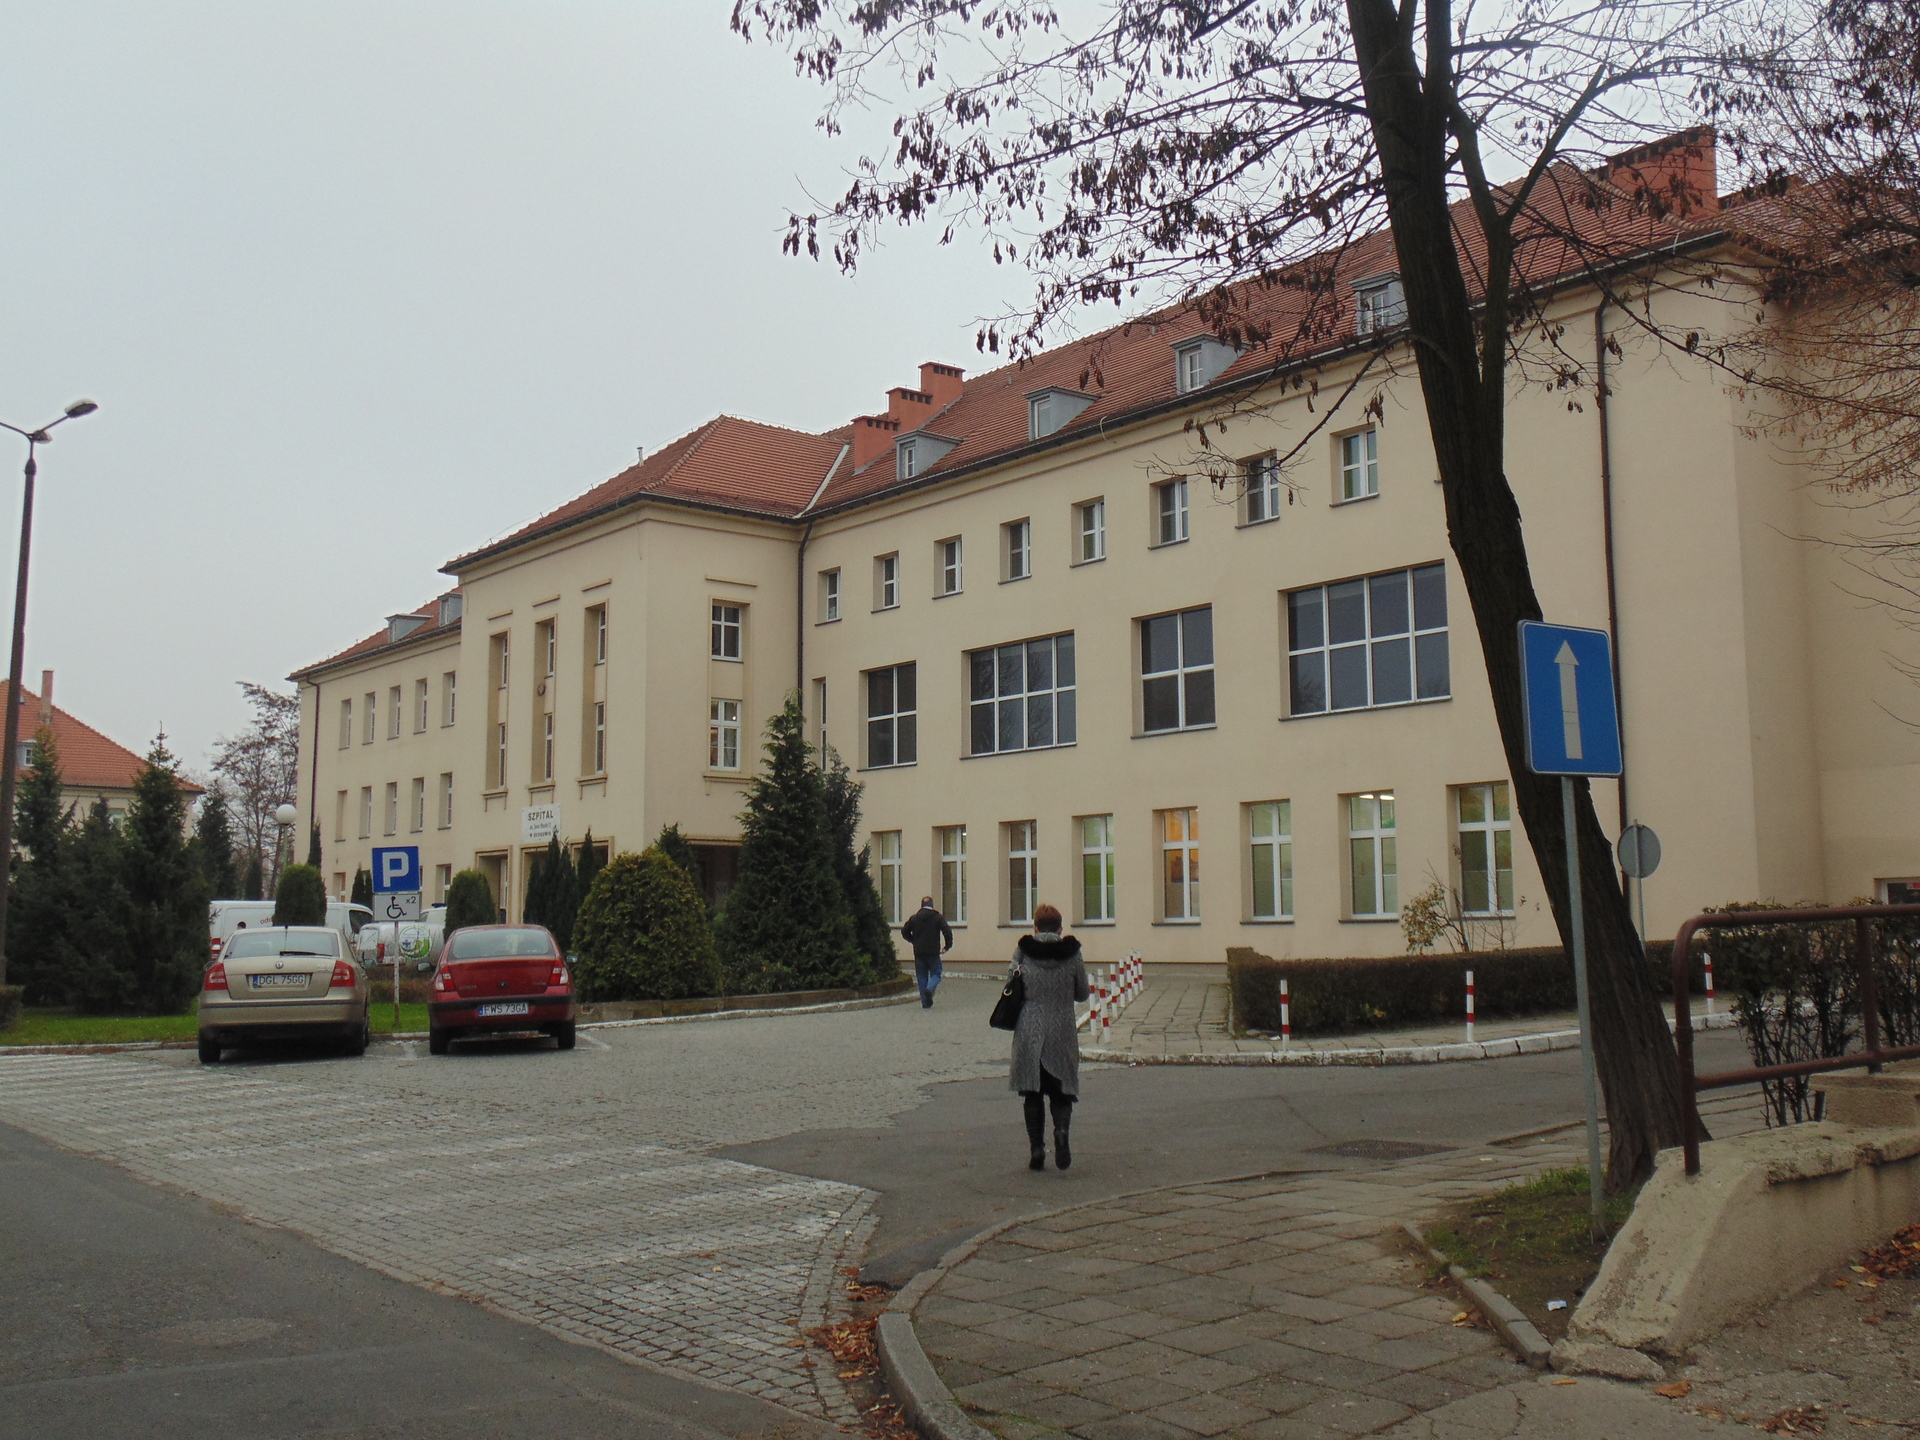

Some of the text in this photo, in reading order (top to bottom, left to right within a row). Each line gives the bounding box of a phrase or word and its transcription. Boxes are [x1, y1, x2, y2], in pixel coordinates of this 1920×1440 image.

[528, 811, 553, 821] SZPITAL
[382, 852, 409, 888] P
[259, 975, 278, 985] DGL
[484, 1004, 503, 1014] FWS
